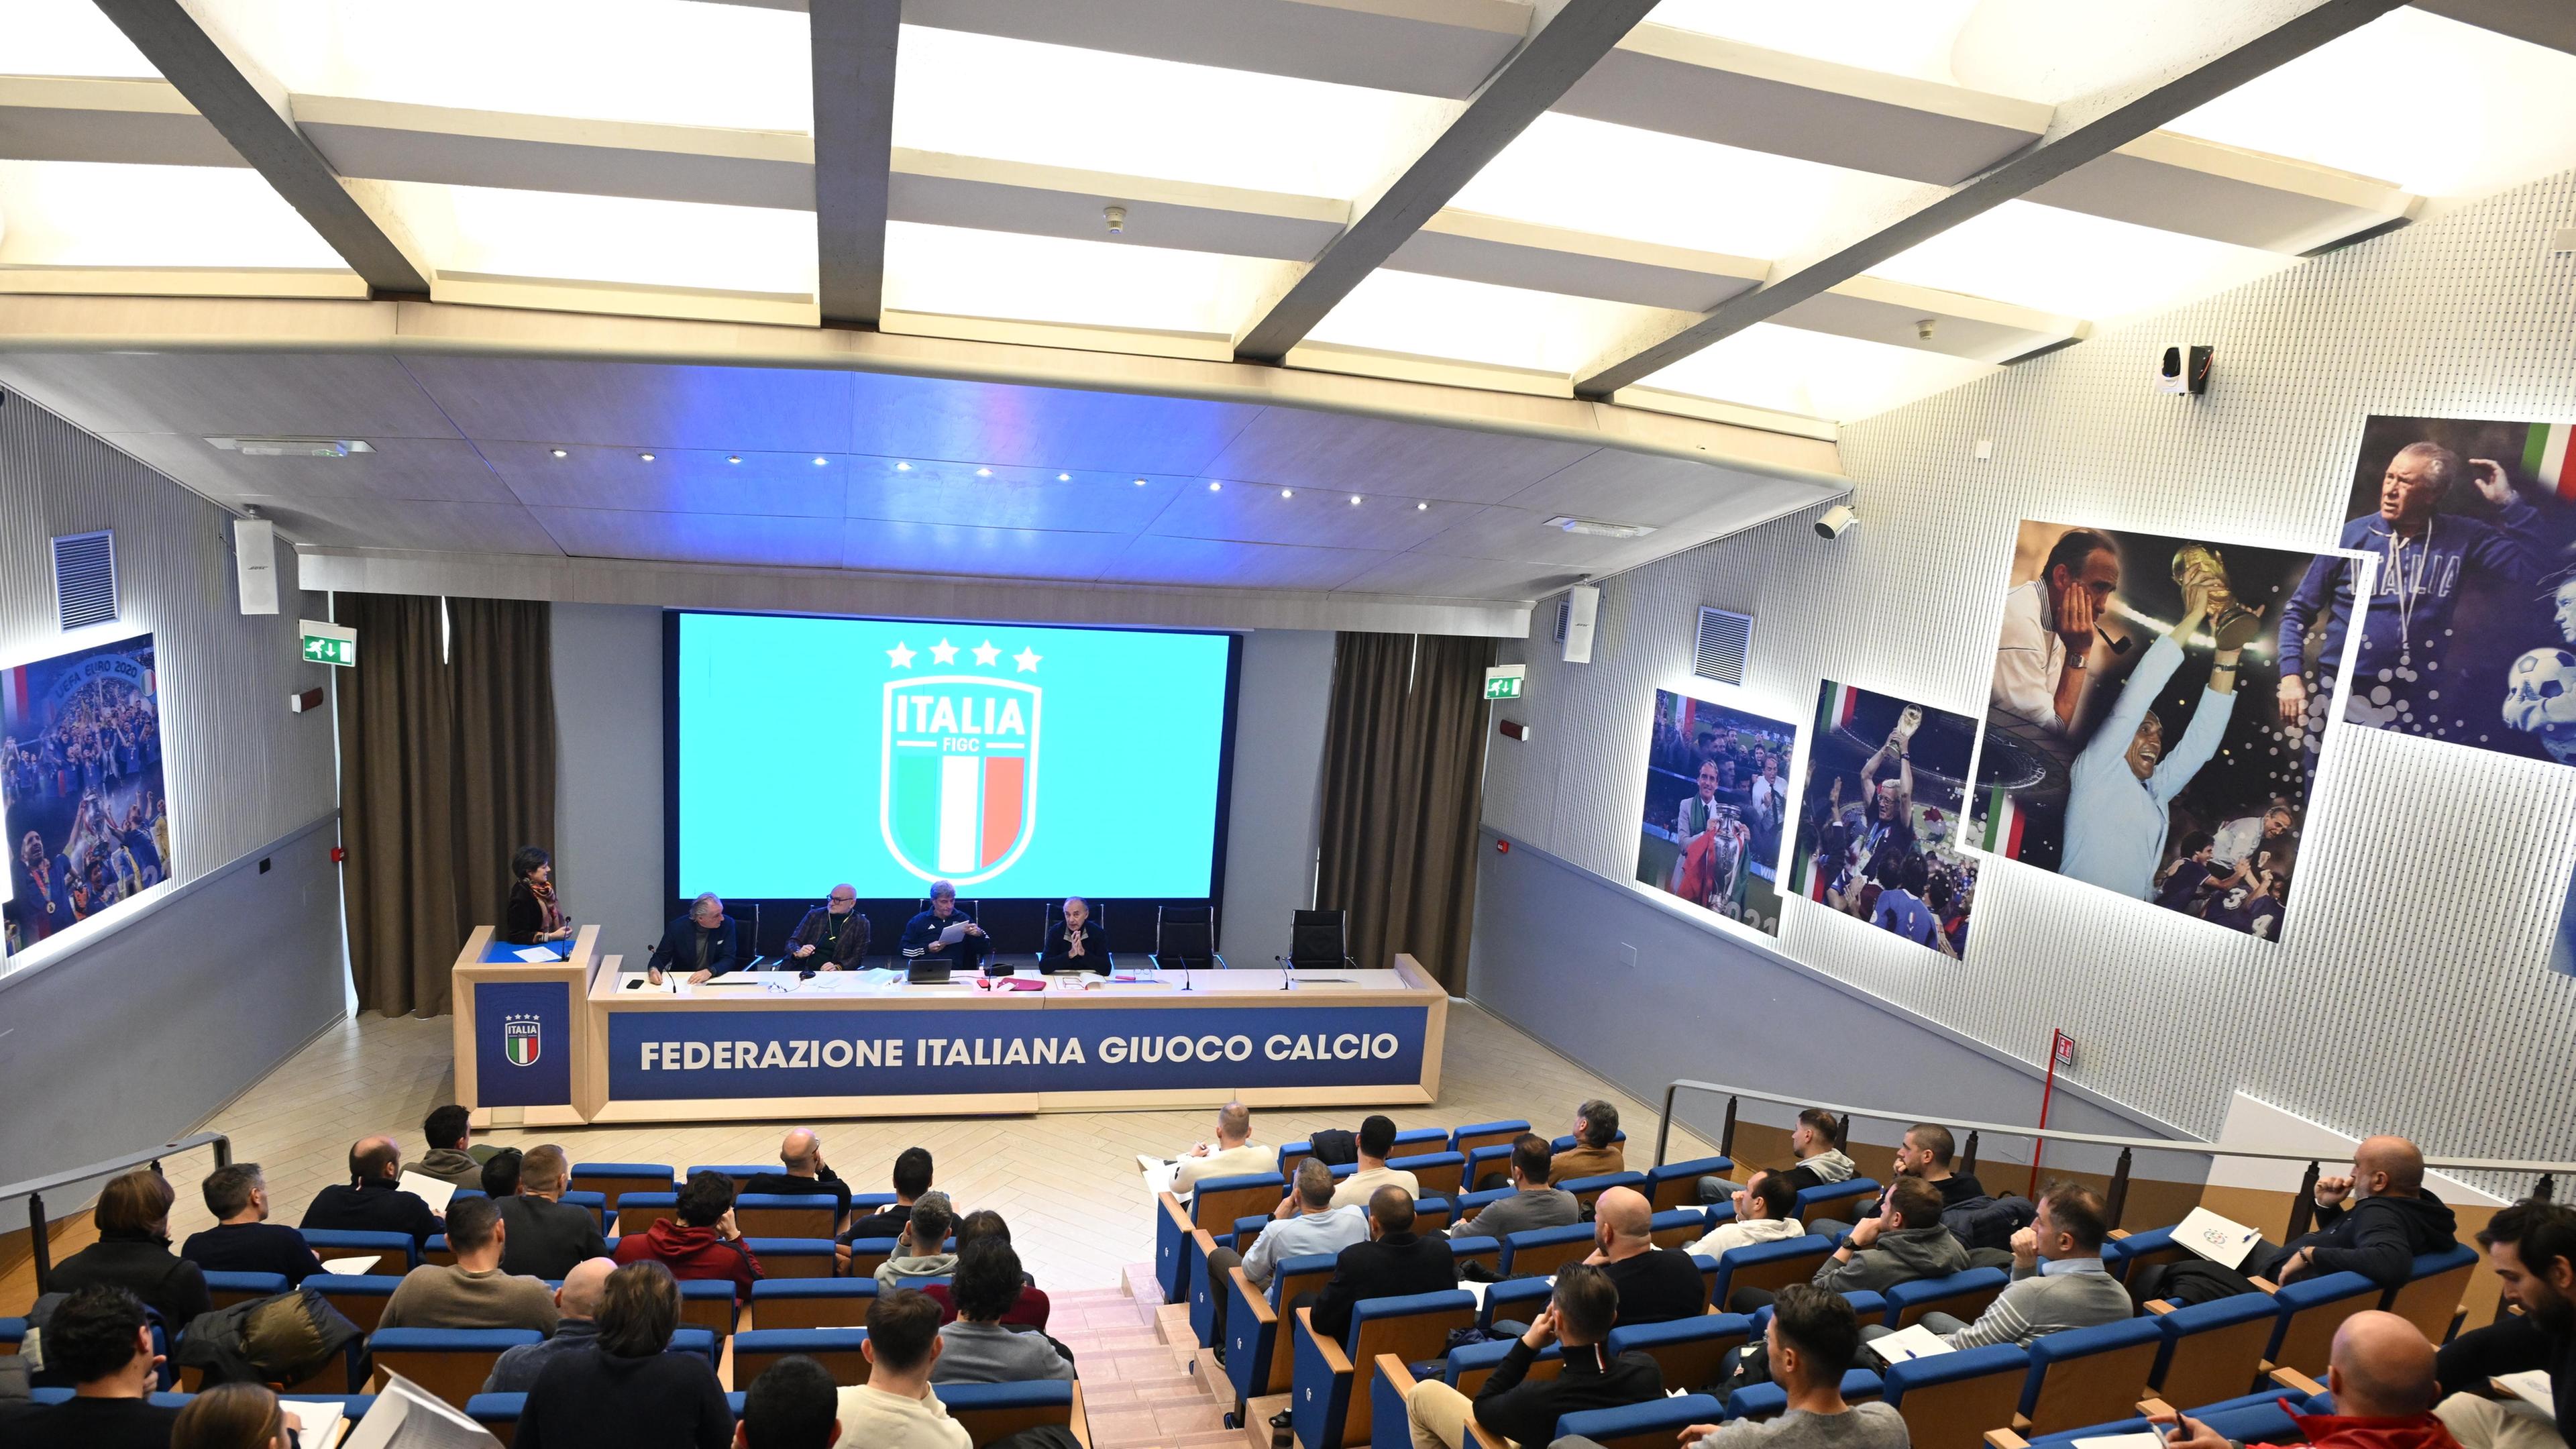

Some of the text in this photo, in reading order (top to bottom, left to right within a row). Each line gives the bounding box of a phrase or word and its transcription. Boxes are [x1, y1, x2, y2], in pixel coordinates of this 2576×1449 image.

[55, 660, 138, 698] UEFA EURO 2020
[897, 695, 1025, 735] ITALIA
[943, 737, 979, 752] FIGC
[2222, 888, 2248, 910] 3
[2252, 914, 2274, 937] 4
[508, 1026, 537, 1034] ITALIA
[641, 1033, 1398, 1070] FEDERAZIONE ITALIANA GIUOCO CALCIO
